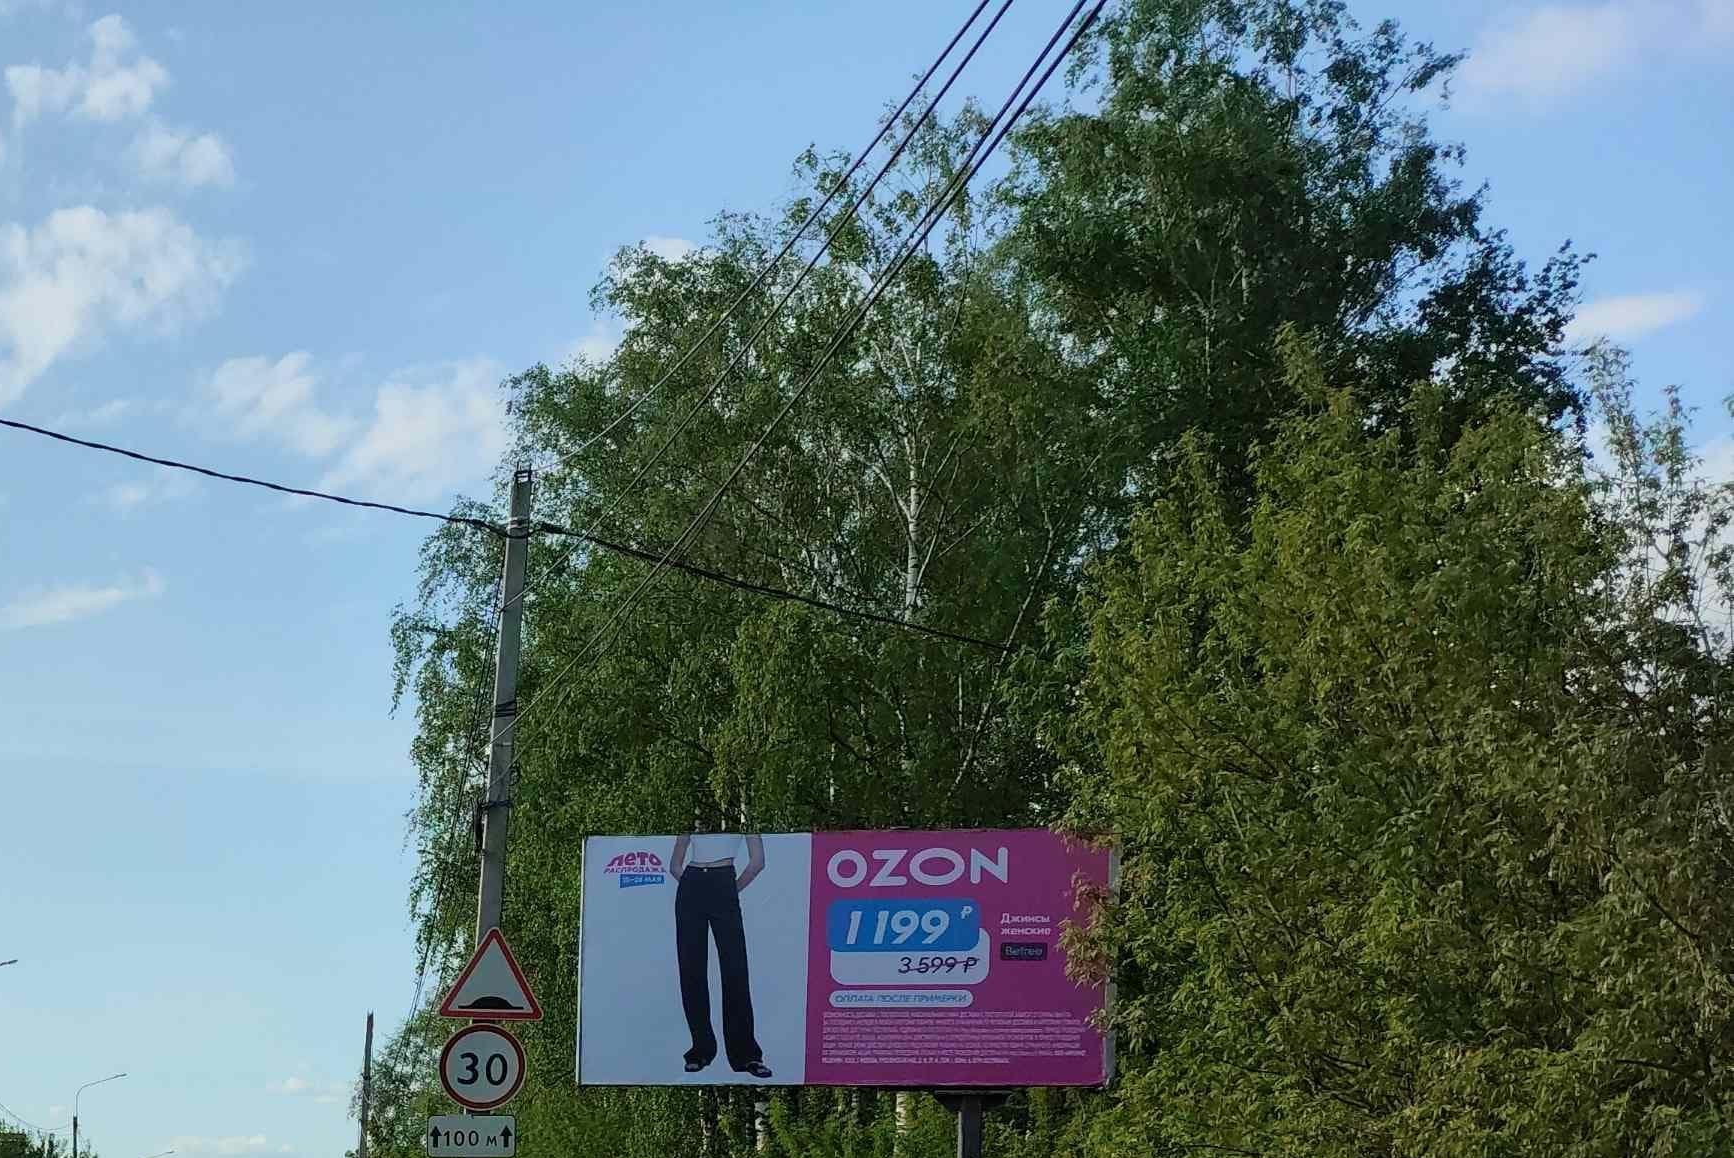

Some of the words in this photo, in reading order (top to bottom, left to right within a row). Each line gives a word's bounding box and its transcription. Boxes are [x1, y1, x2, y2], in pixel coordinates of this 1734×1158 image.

[827, 847, 1009, 888] OZON
[1000, 912, 1051, 924] Джинсы
[1000, 927, 1051, 936] женские
[457, 1052, 508, 1086] 30
[443, 1130, 479, 1147] 100
